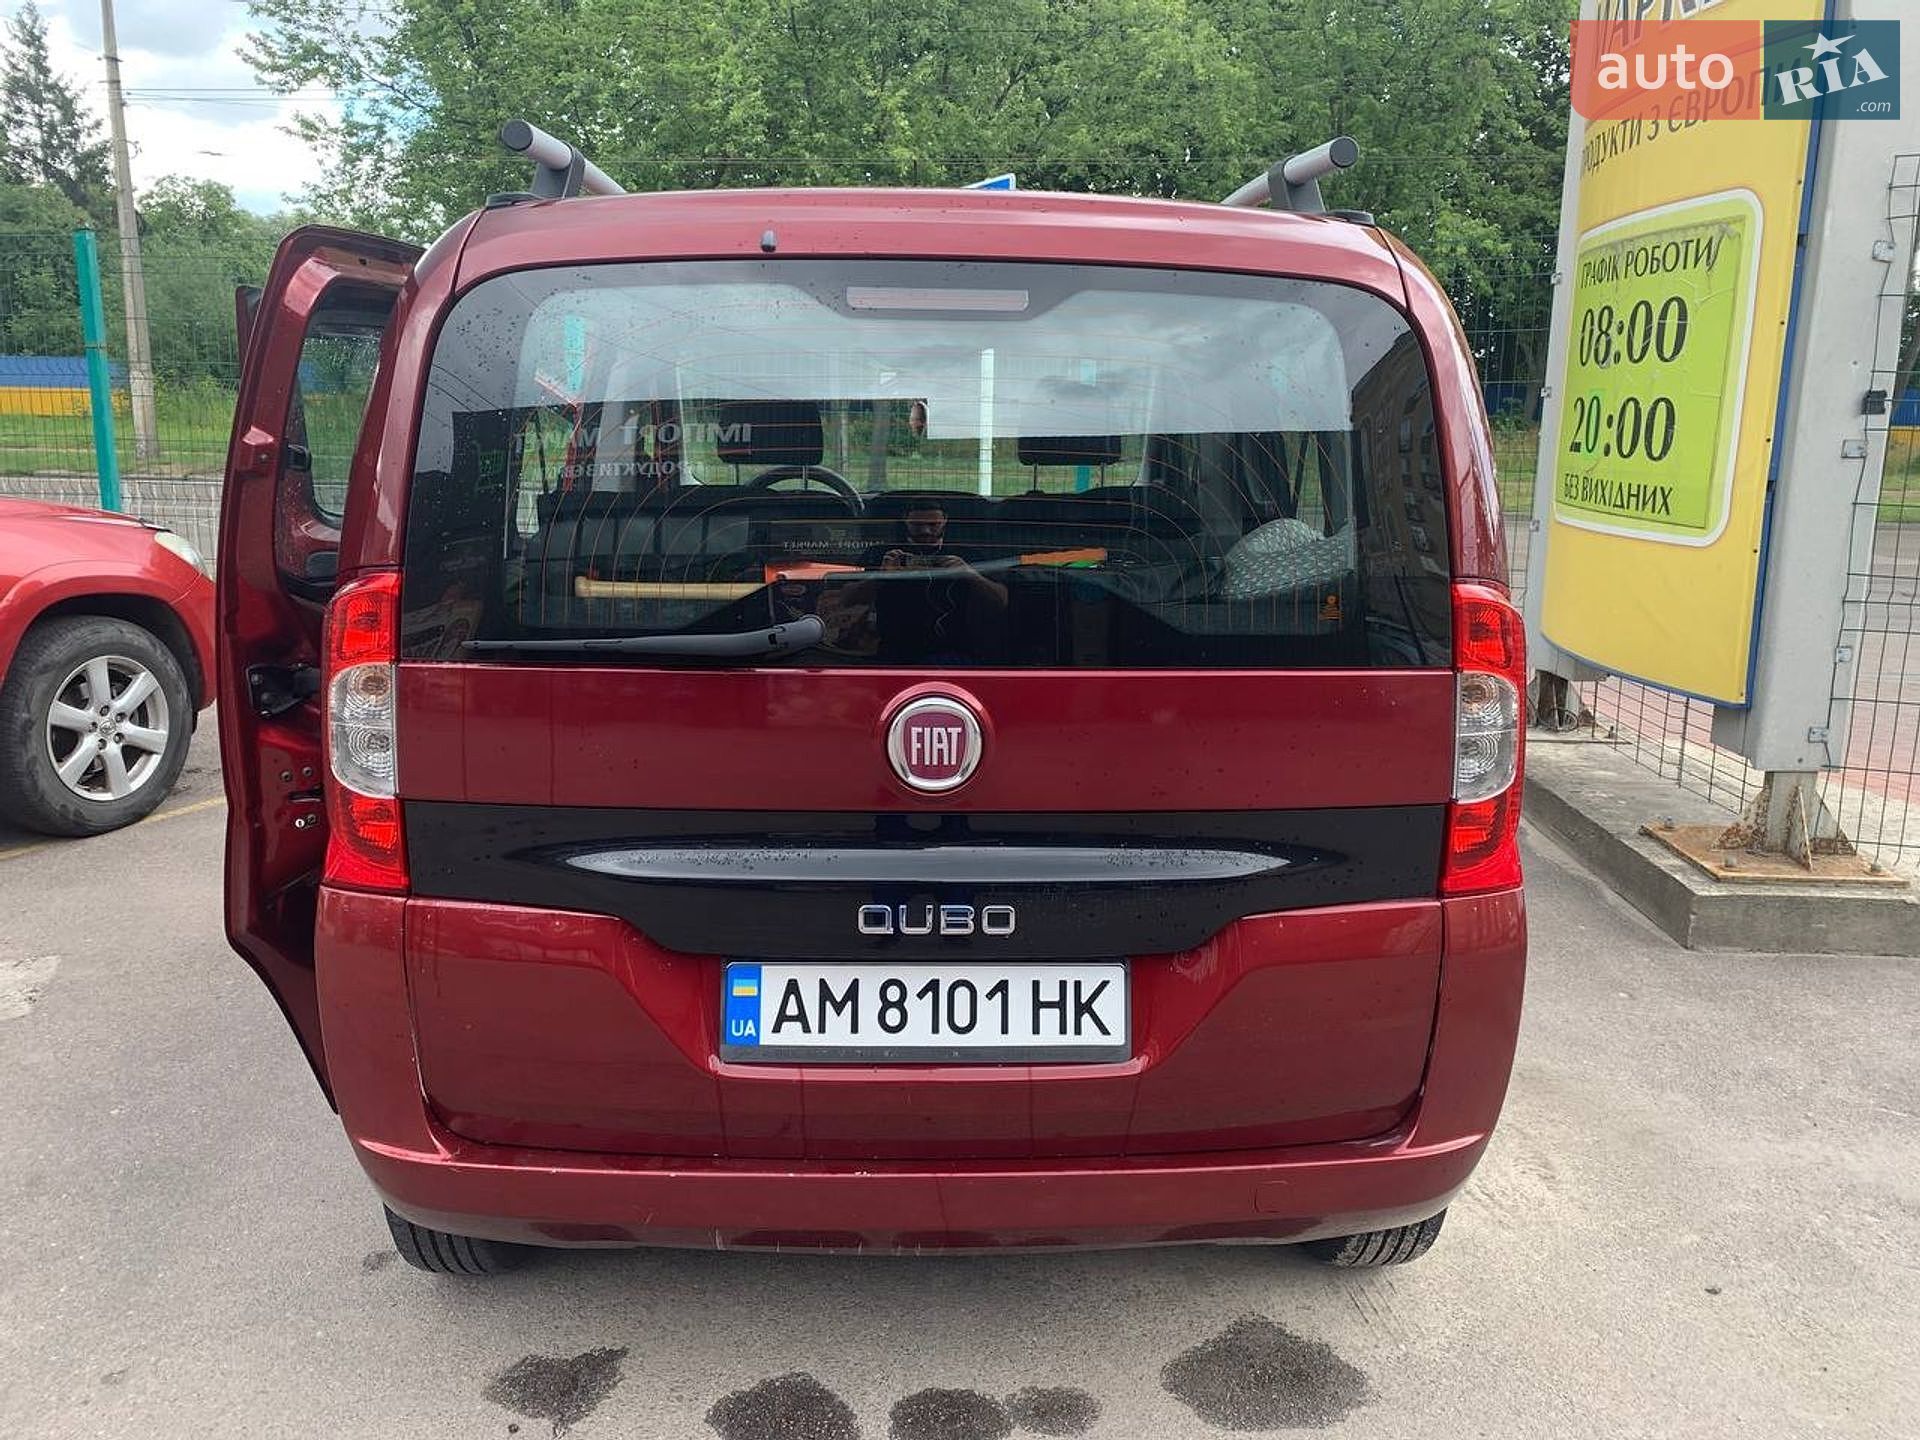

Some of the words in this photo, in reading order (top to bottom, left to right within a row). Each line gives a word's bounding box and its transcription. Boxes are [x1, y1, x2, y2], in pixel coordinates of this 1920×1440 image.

[1581, 257, 1619, 288] ГРАФІК
[1624, 239, 1712, 279] РОБОТИ
[1579, 296, 1689, 368] 08:00
[1568, 396, 1676, 461] 20:00
[1581, 477, 1673, 516] ВИХІДНИХ
[911, 727, 961, 765] FIAT
[857, 904, 1016, 935] QUBO
[731, 1020, 757, 1037] UA
[771, 978, 859, 1035] AM
[877, 978, 1010, 1035] 8101
[1032, 979, 1111, 1035] HK
